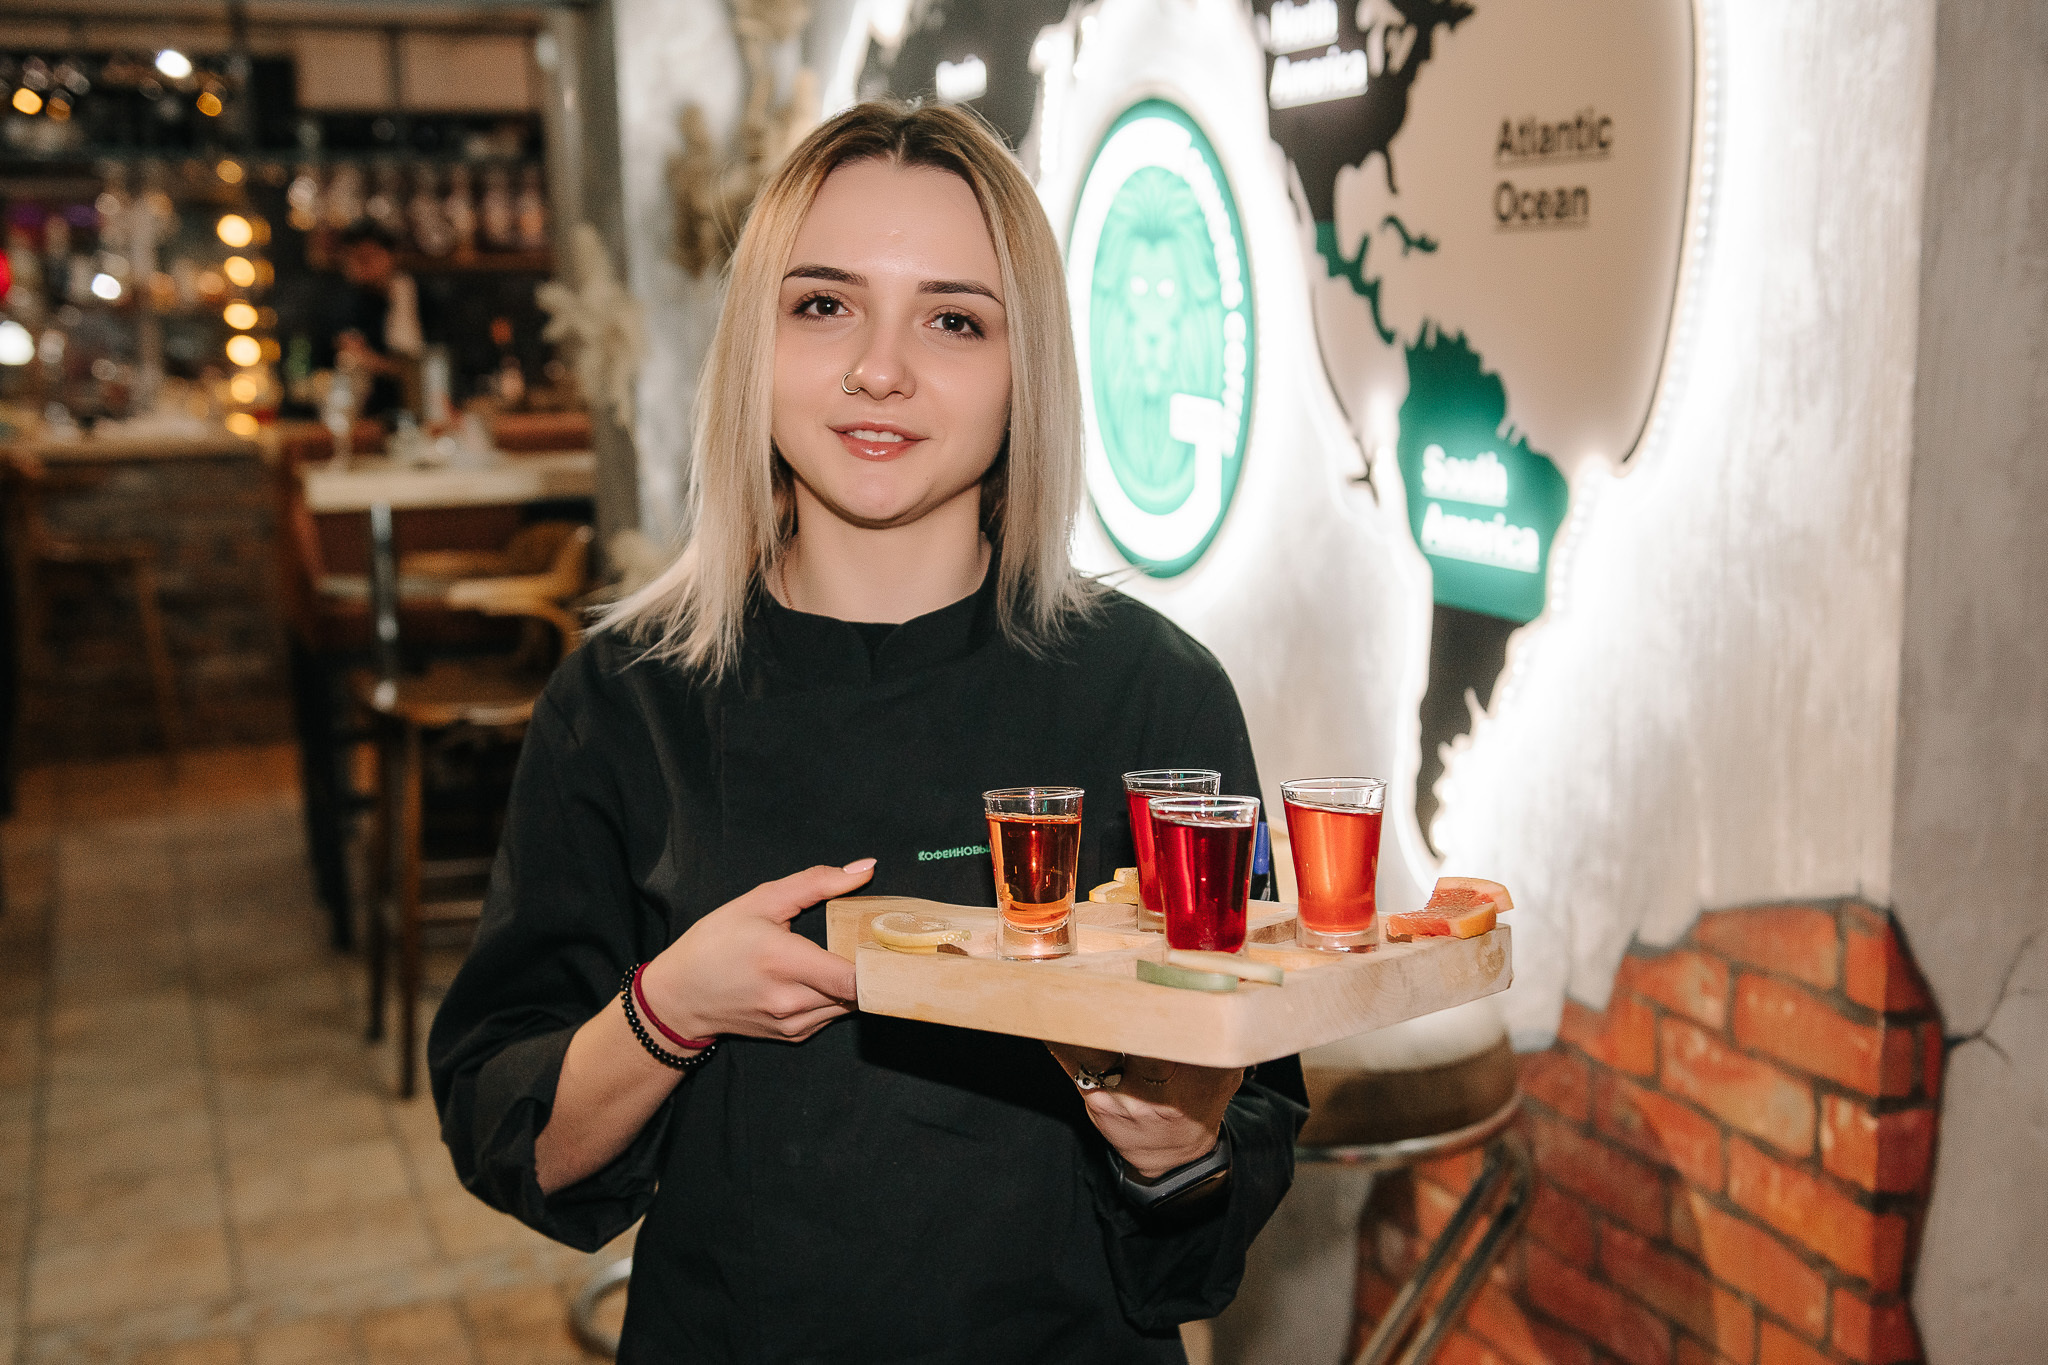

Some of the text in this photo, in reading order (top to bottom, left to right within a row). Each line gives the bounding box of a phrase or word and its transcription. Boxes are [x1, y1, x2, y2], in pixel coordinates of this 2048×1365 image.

[1496, 109, 1612, 159] Atlantic
[1495, 180, 1590, 226] Ocean
[1421, 443, 1508, 502] South
[1420, 502, 1540, 570] America
